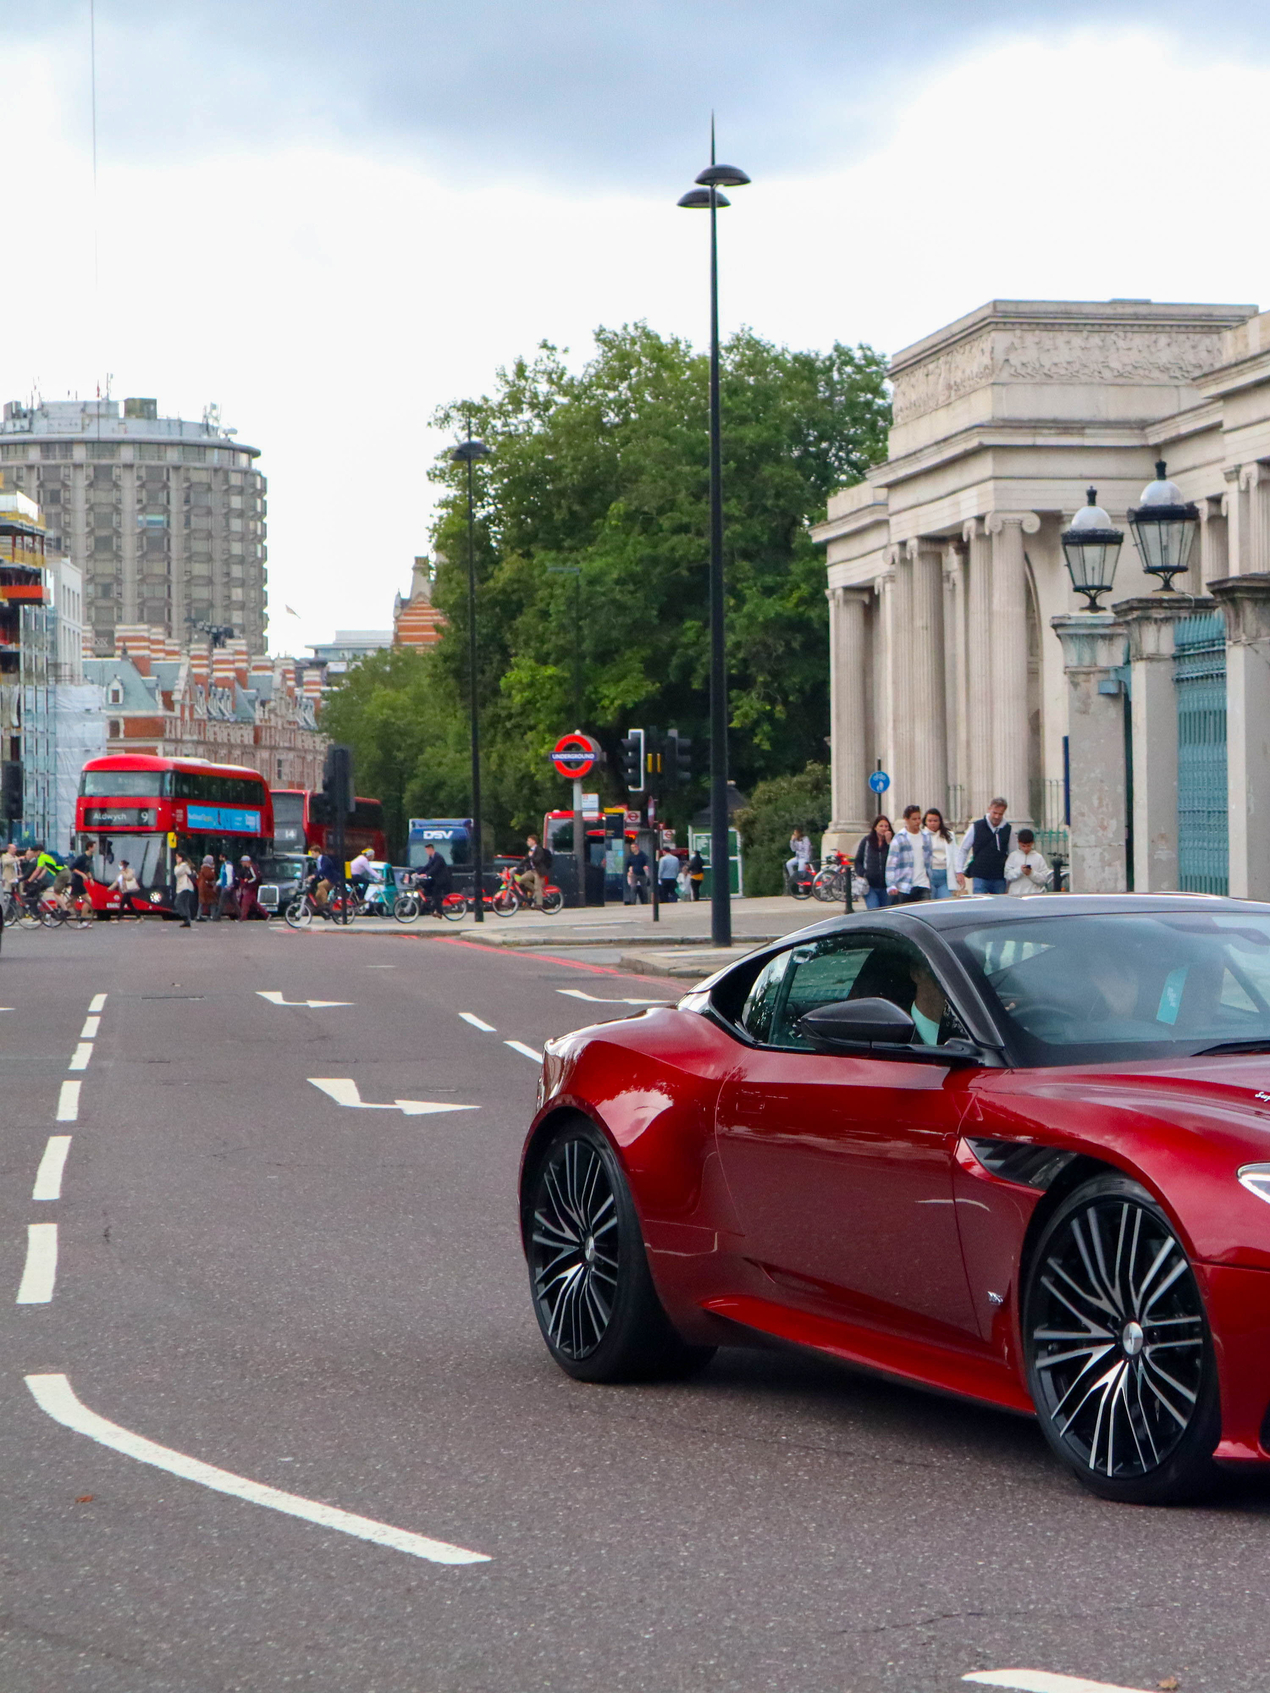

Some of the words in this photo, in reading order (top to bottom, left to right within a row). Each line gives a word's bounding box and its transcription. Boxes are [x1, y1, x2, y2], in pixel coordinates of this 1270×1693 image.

[93, 812, 127, 822] Aldwych
[141, 811, 149, 823] 9
[285, 829, 295, 839] 14
[423, 830, 453, 839] DSV
